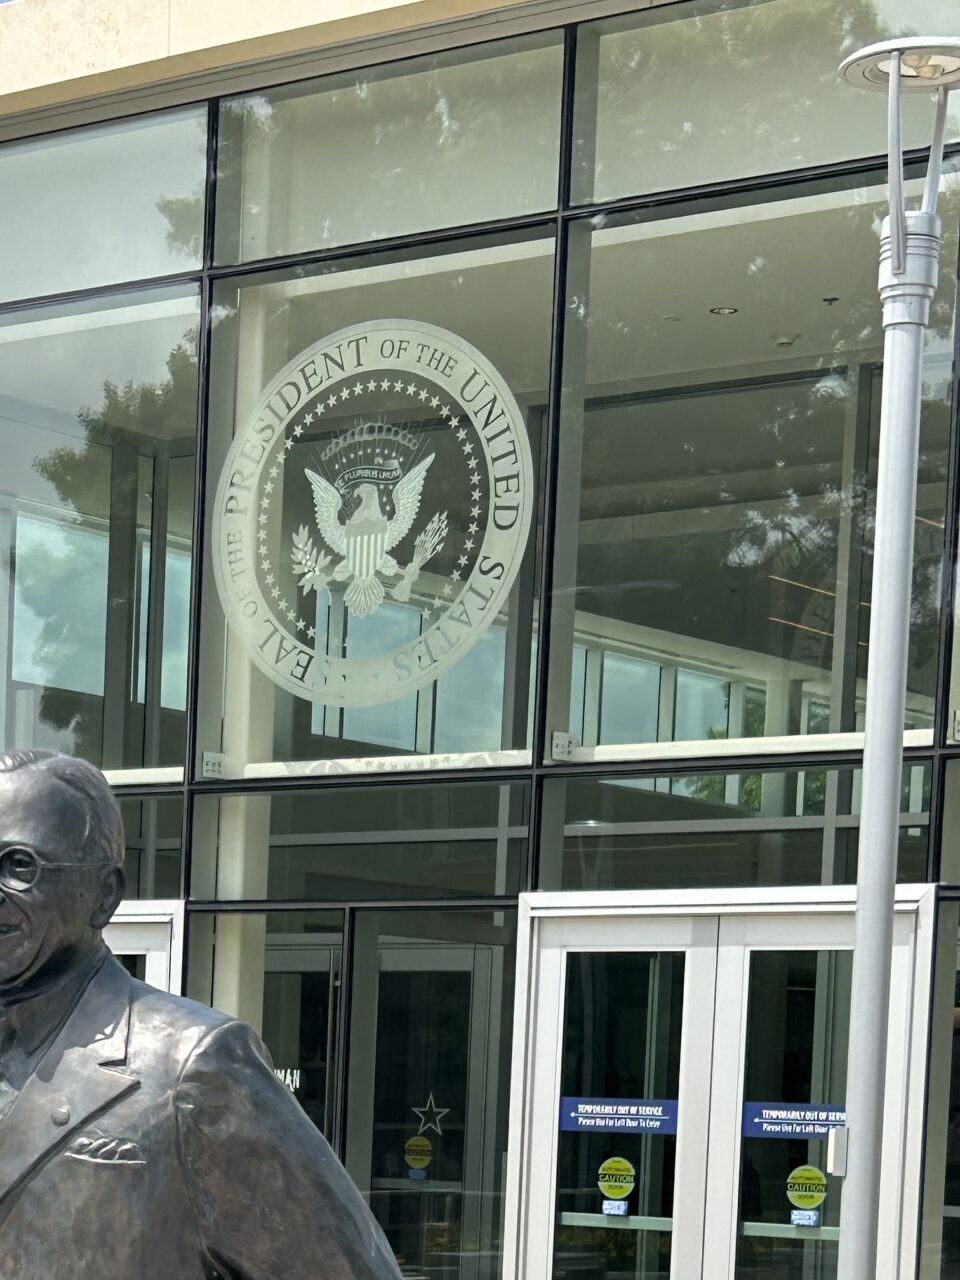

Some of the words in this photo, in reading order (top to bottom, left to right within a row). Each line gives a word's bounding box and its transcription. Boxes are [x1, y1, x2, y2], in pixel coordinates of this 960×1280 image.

[380, 338, 409, 359] OF
[416, 342, 458, 378] THE
[225, 336, 369, 517] PRESIDENT
[459, 368, 521, 532] UNITED
[227, 530, 246, 583] THE
[394, 554, 506, 683] STATES
[617, 1105, 629, 1114] OUT
[630, 1106, 637, 1115] OF
[639, 1106, 663, 1116] SERVICE
[762, 1109, 805, 1120] TEMPORARILY
[805, 1111, 817, 1120] OUT
[819, 1111, 828, 1120] OF
[599, 1174, 634, 1182] CAUTION
[787, 1183, 826, 1193] CAUTION
